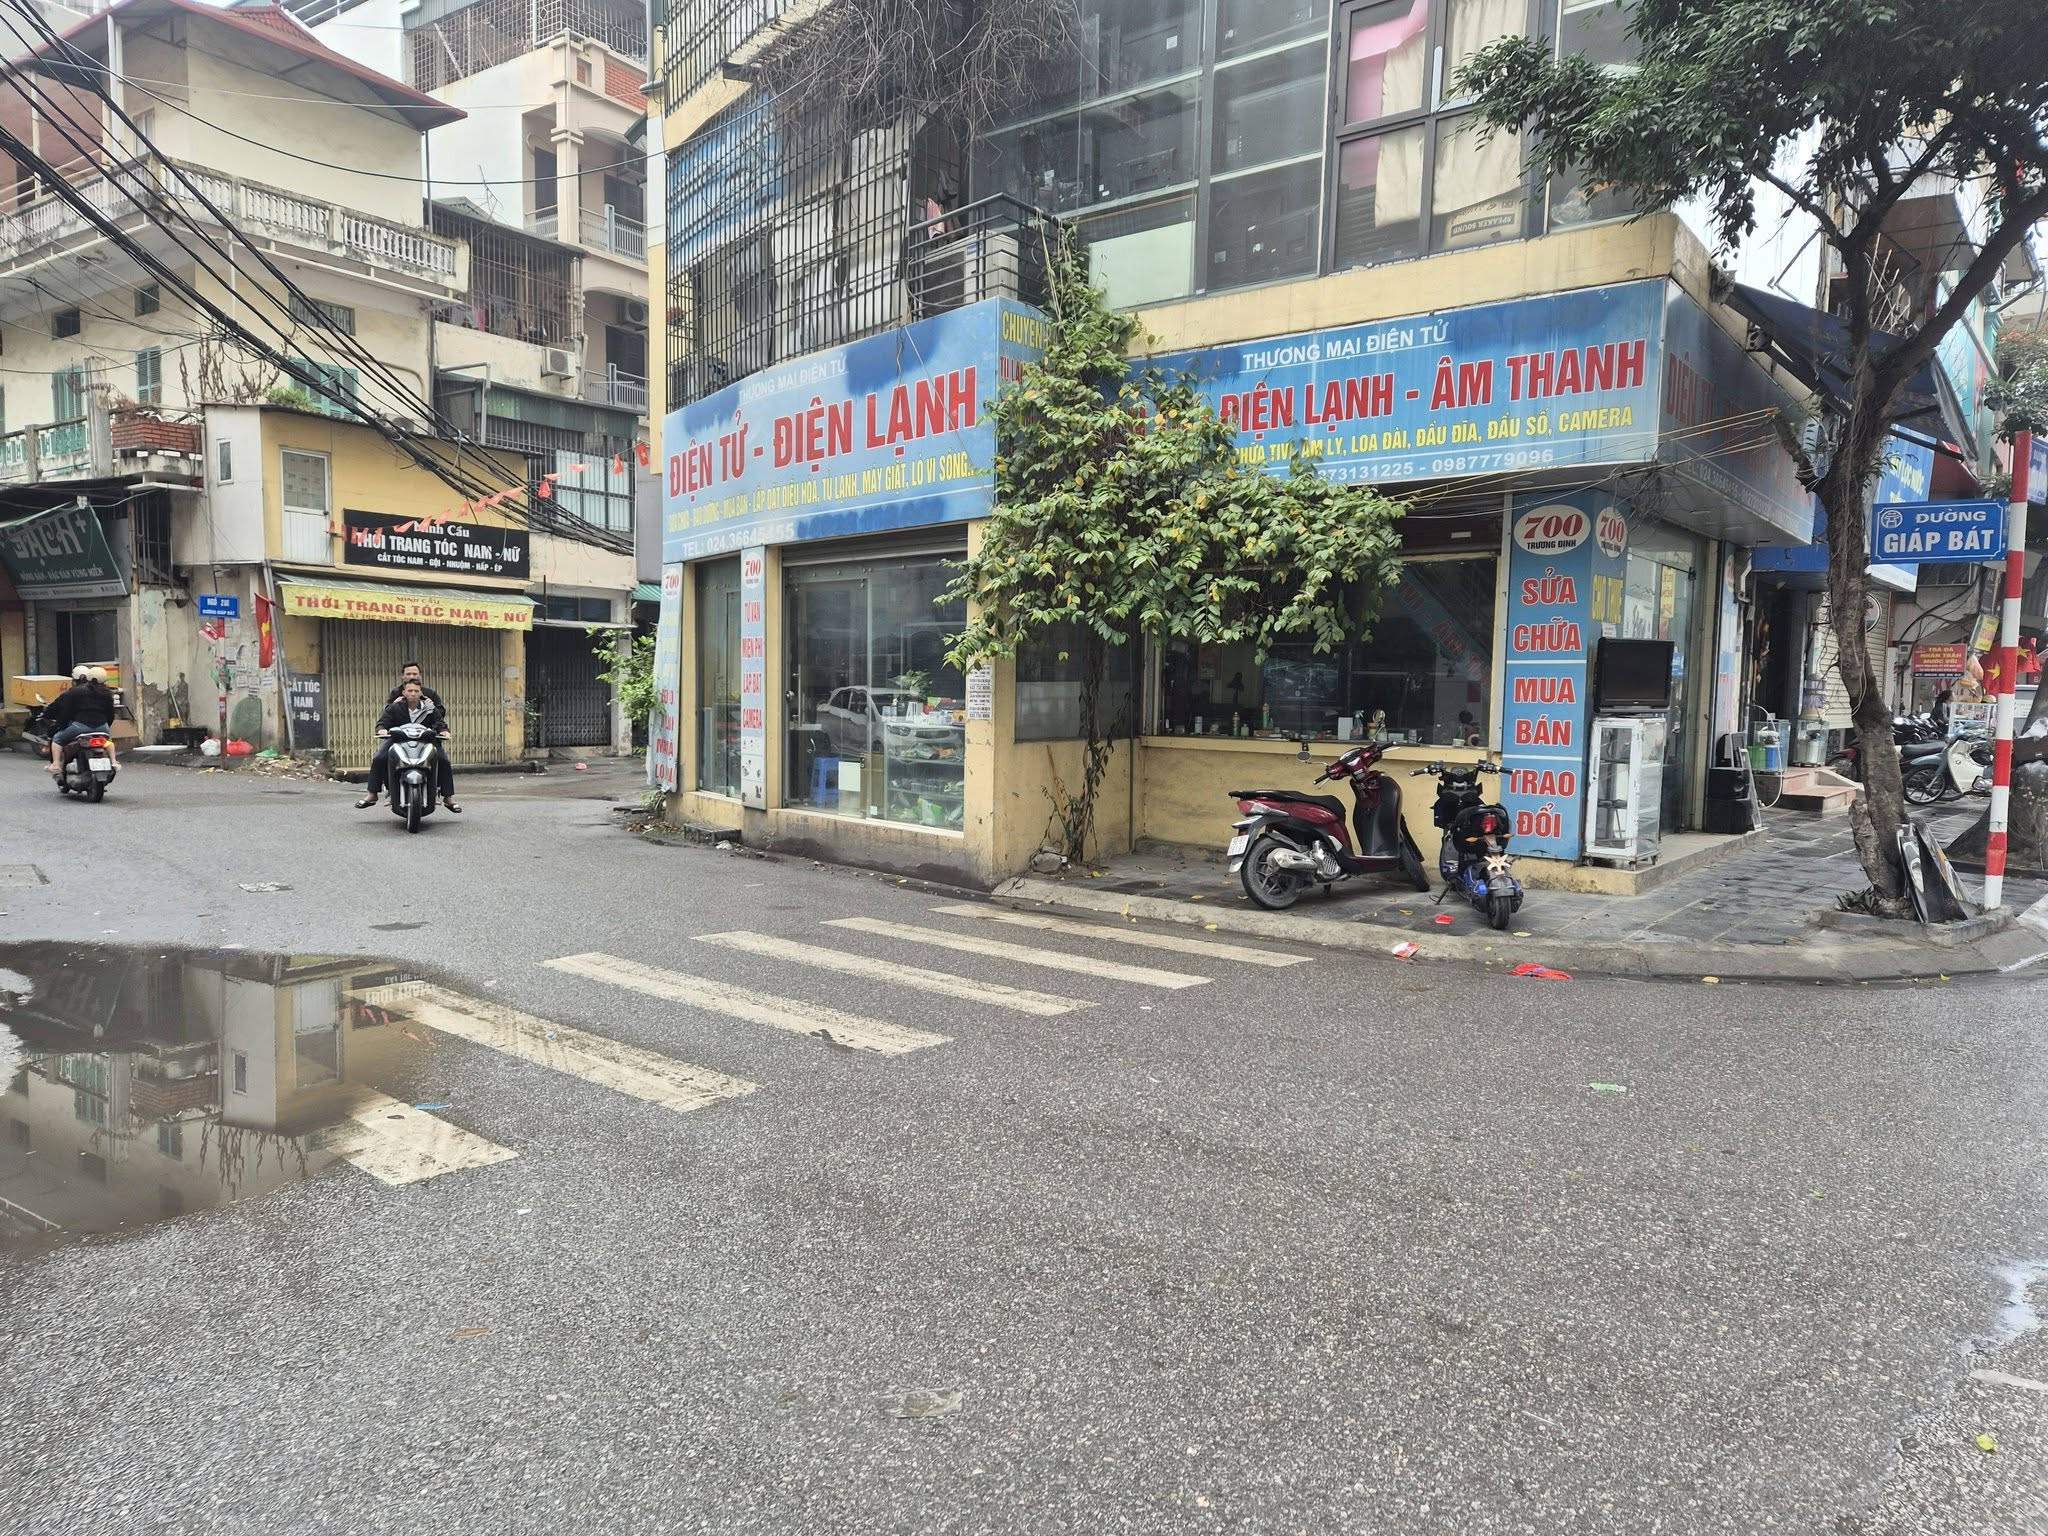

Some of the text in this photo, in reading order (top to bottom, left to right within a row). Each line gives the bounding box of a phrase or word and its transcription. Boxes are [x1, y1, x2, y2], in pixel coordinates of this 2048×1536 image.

[1002, 310, 1042, 350] CHUYÊN
[1243, 319, 1450, 371] THƯƠNG MẠI ĐIỆN TỬ
[1219, 380, 1294, 440] ĐIỆN
[1304, 372, 1395, 433] LẠNH
[1429, 354, 1494, 411] ÂM
[1506, 338, 1647, 402] THANH
[669, 438, 713, 502] ĐIỆN
[719, 409, 748, 482] TỬ
[773, 394, 853, 473] ĐIỆN
[866, 365, 978, 456] LẠNH
[1352, 433, 1378, 453] LOA
[1382, 427, 1411, 450] ĐÀI,
[1416, 420, 1447, 446] ĐẦU
[1451, 420, 1482, 444] ĐĨA,
[1487, 412, 1521, 440] ĐẦU
[1526, 408, 1553, 437] SỐ,
[1558, 405, 1633, 433] CAMERA
[926, 457, 936, 483] VI
[1432, 449, 1554, 473] 0987779096
[1523, 513, 1583, 539] 700
[1600, 515, 1625, 543] 700
[1916, 508, 1987, 523] ĐƯỜNG
[389, 535, 431, 554] TRANG
[434, 536, 458, 557] TÓC
[464, 543, 493, 561] NAM
[503, 545, 521, 563] NỮ
[1526, 539, 1577, 550] TRƯƠNG ĐỊNH
[1884, 525, 1995, 553] GIÁP BÁT
[407, 556, 424, 566] NAM
[745, 559, 761, 577] 700
[666, 574, 680, 589] 700
[1522, 567, 1577, 606] SỬA
[345, 600, 406, 615] TRANG
[411, 603, 444, 618] TÓC
[449, 608, 489, 621] NAM
[1512, 617, 1582, 652] CHỮA
[304, 680, 320, 693] TÓC
[1513, 677, 1577, 704] MUA
[293, 696, 314, 708] NAM
[1514, 715, 1572, 747] BÁN
[1509, 769, 1577, 798] TRAO
[1516, 803, 1561, 838] ĐỔI
